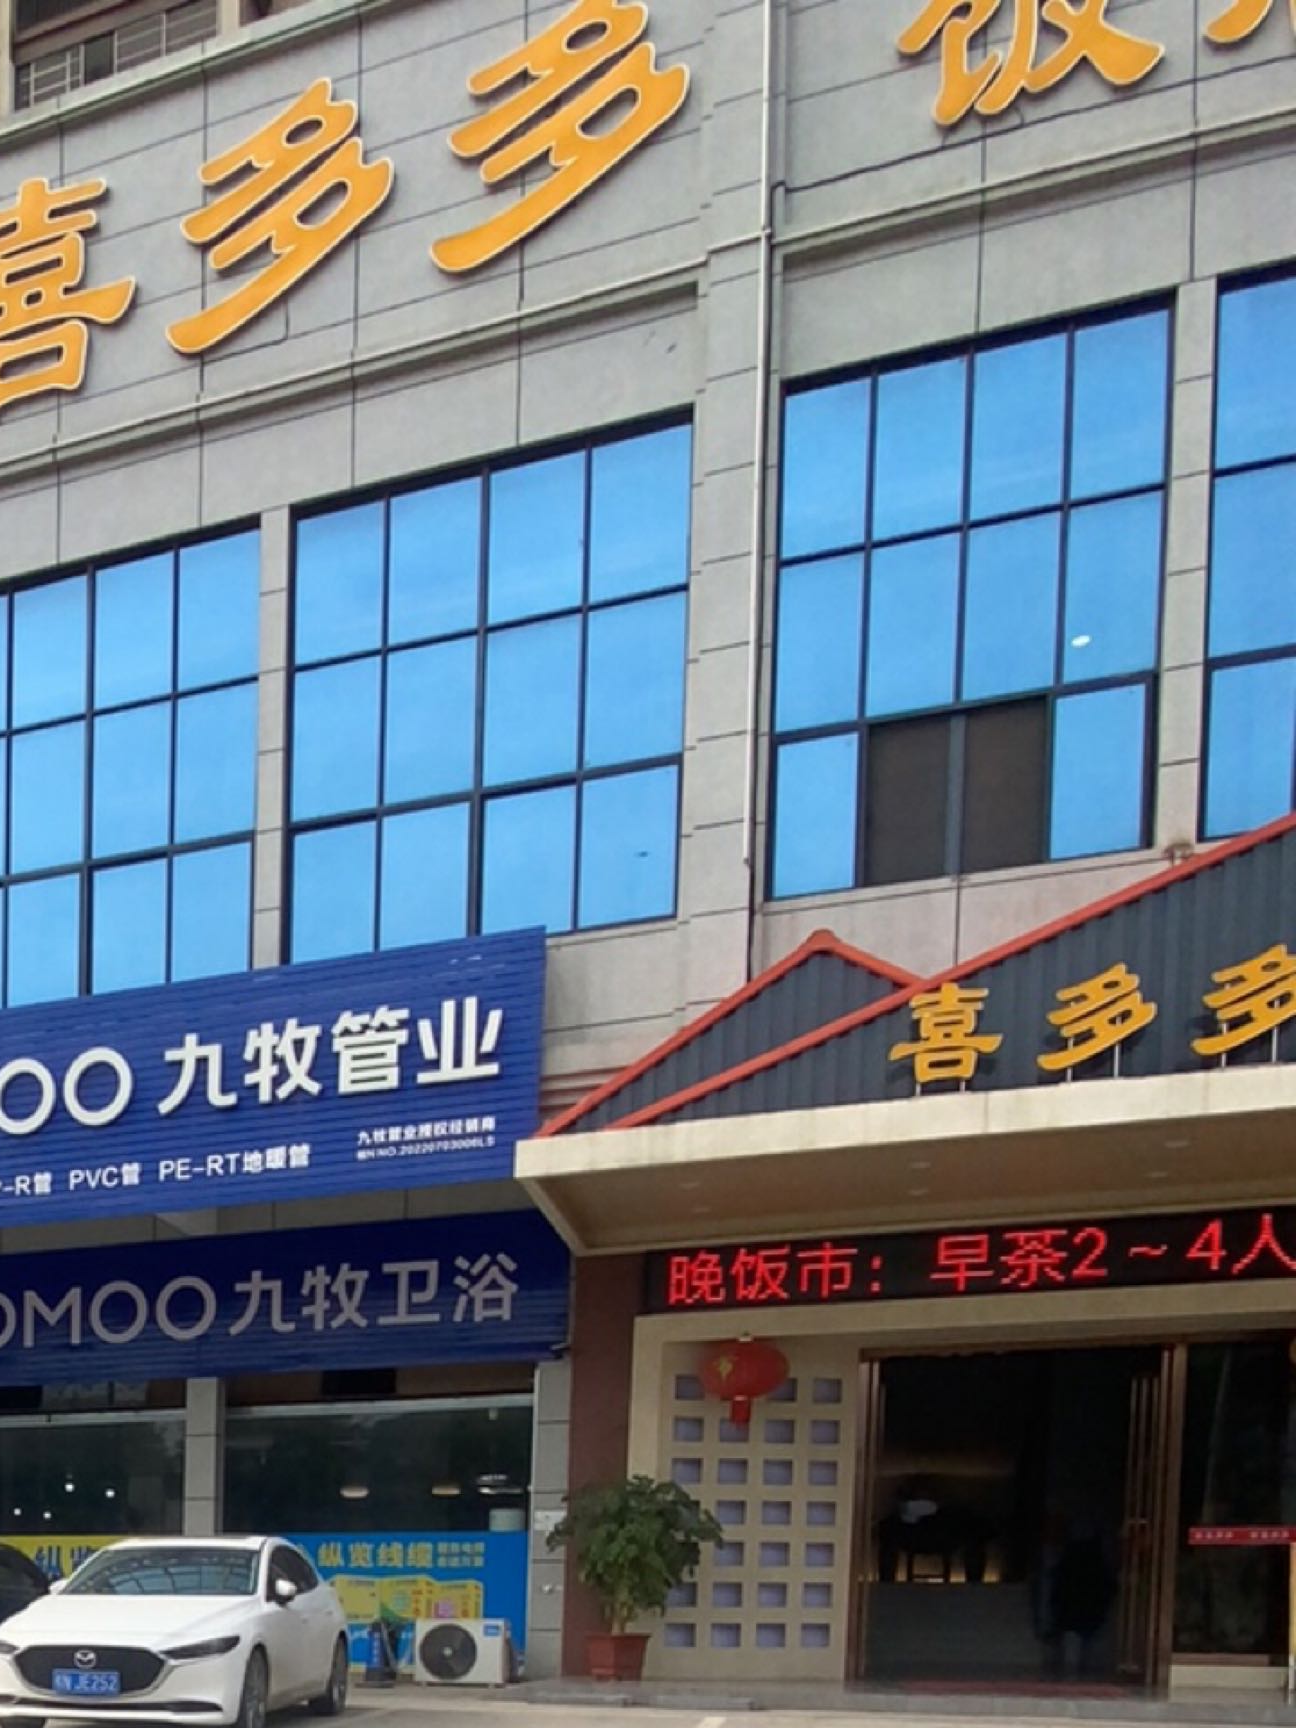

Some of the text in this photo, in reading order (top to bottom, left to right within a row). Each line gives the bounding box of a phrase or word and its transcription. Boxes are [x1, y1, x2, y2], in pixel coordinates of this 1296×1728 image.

[157, 997, 504, 1114] 九牧管业
[889, 944, 1296, 1083] 喜多多
[68, 1162, 141, 1190] PVC管
